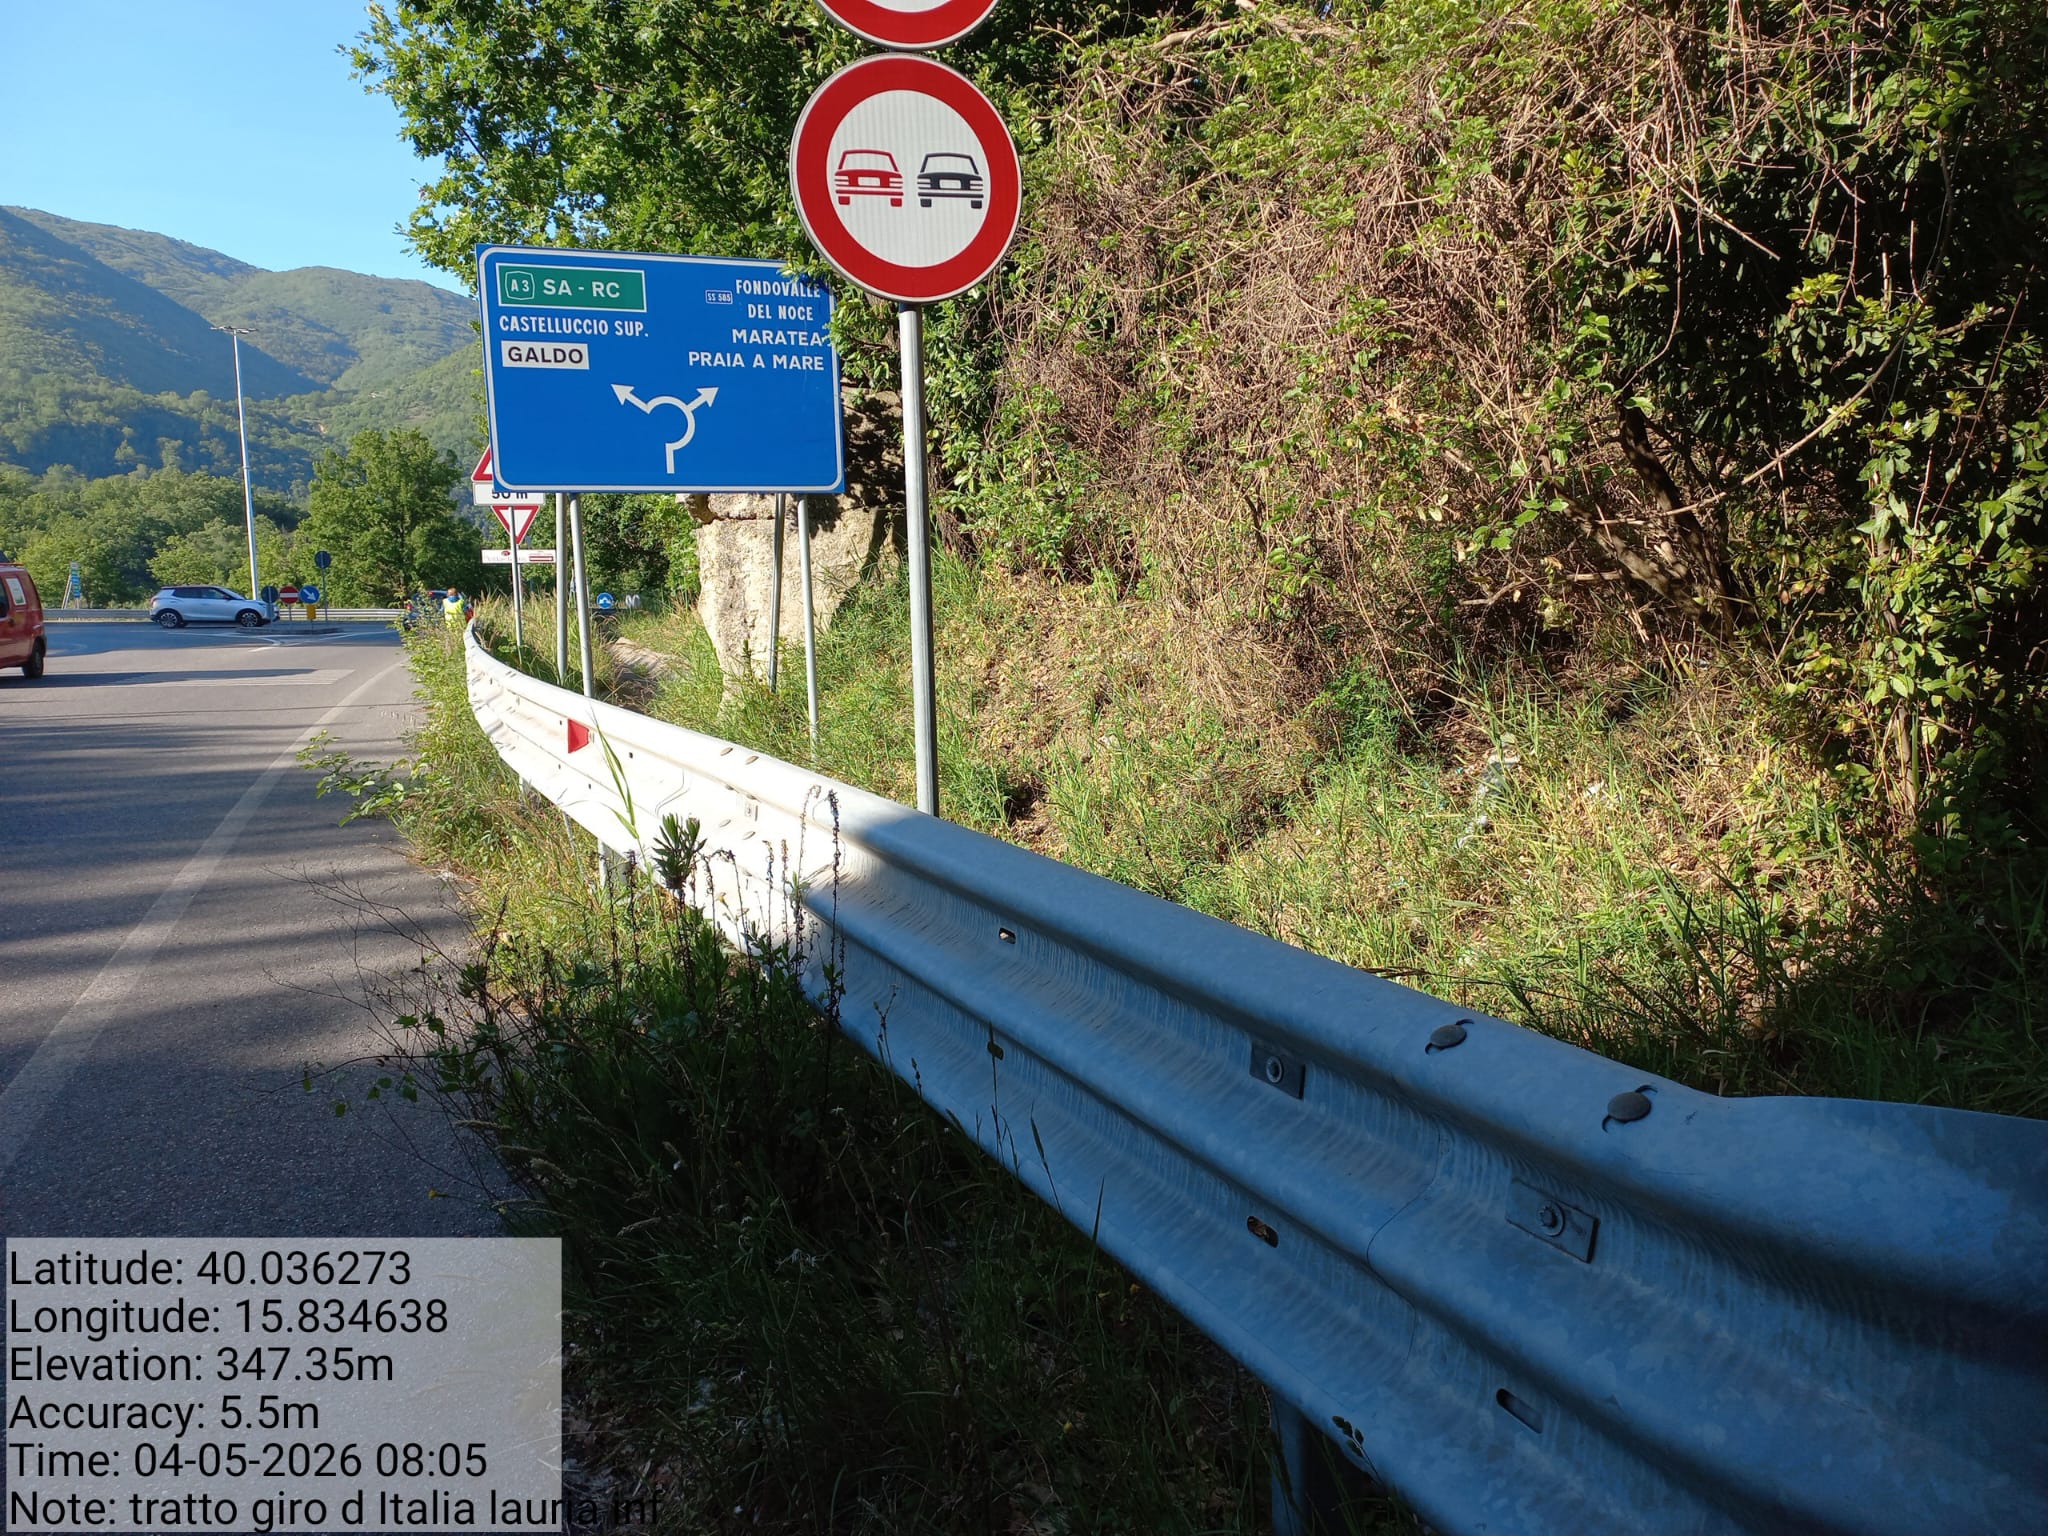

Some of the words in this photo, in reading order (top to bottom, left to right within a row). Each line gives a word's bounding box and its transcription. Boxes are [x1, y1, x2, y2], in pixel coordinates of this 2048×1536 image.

[543, 279, 572, 296] SA
[592, 281, 621, 298] RC
[735, 279, 821, 298] FONDOVALLE
[748, 304, 772, 319] DEL
[778, 305, 814, 321] NOCE
[499, 315, 609, 336] CASTELLUCCIO
[615, 320, 649, 338] SUP.
[732, 328, 823, 347] MARATEA
[508, 346, 584, 364] GALDO
[688, 351, 745, 368] PRAIA
[752, 353, 765, 369] A
[772, 354, 825, 371] MARE
